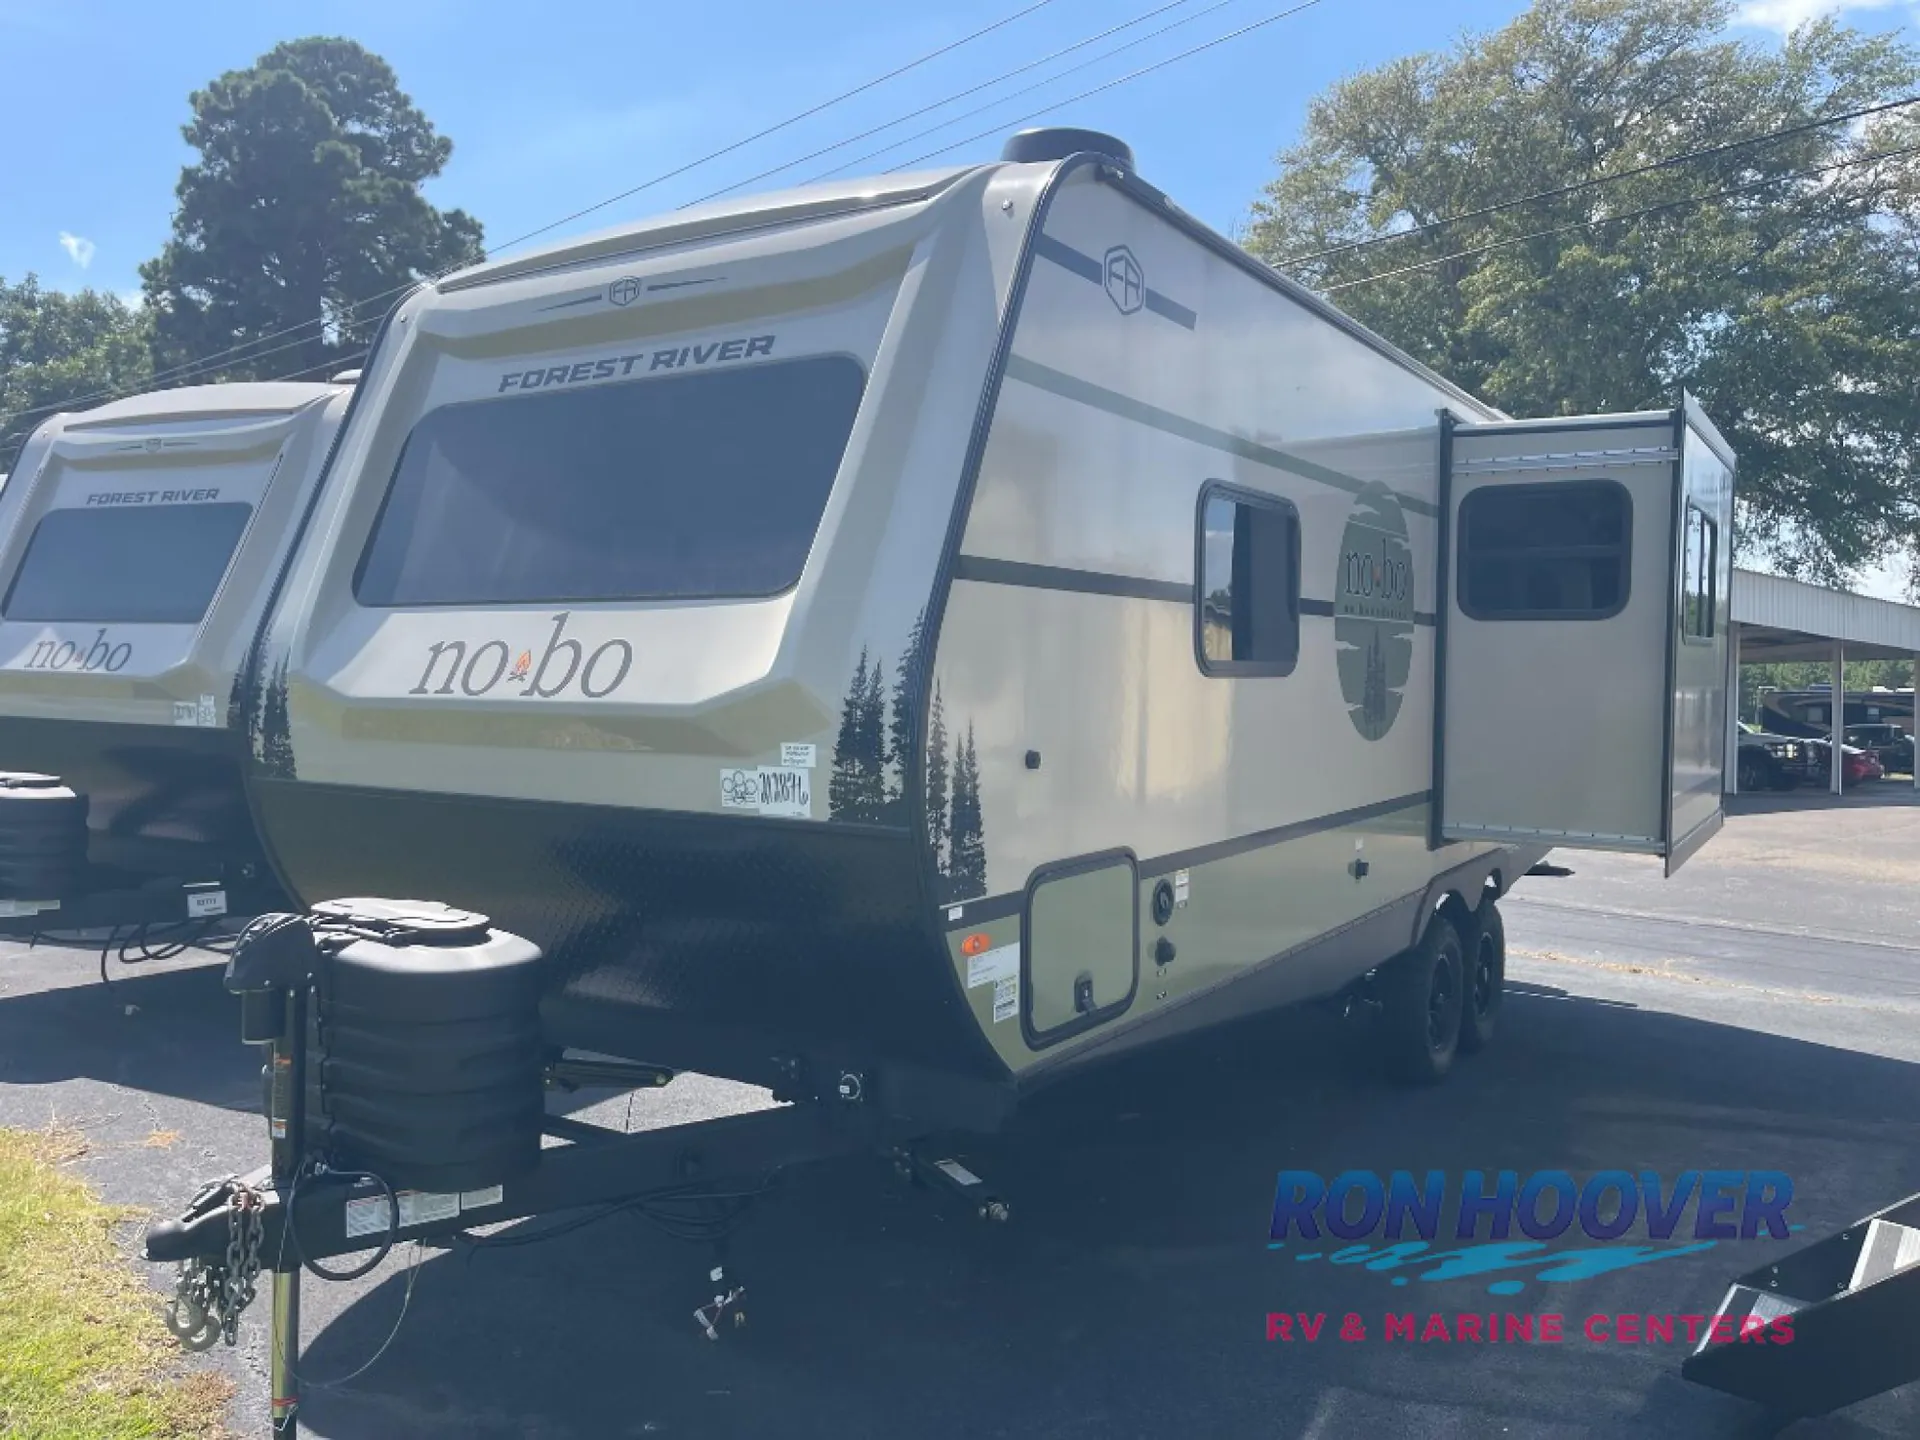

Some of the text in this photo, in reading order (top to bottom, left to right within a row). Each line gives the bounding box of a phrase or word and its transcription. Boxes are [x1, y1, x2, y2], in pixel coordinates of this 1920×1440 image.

[498, 335, 776, 393] FOREST RIVER
[86, 487, 220, 505] FOREST RIVER
